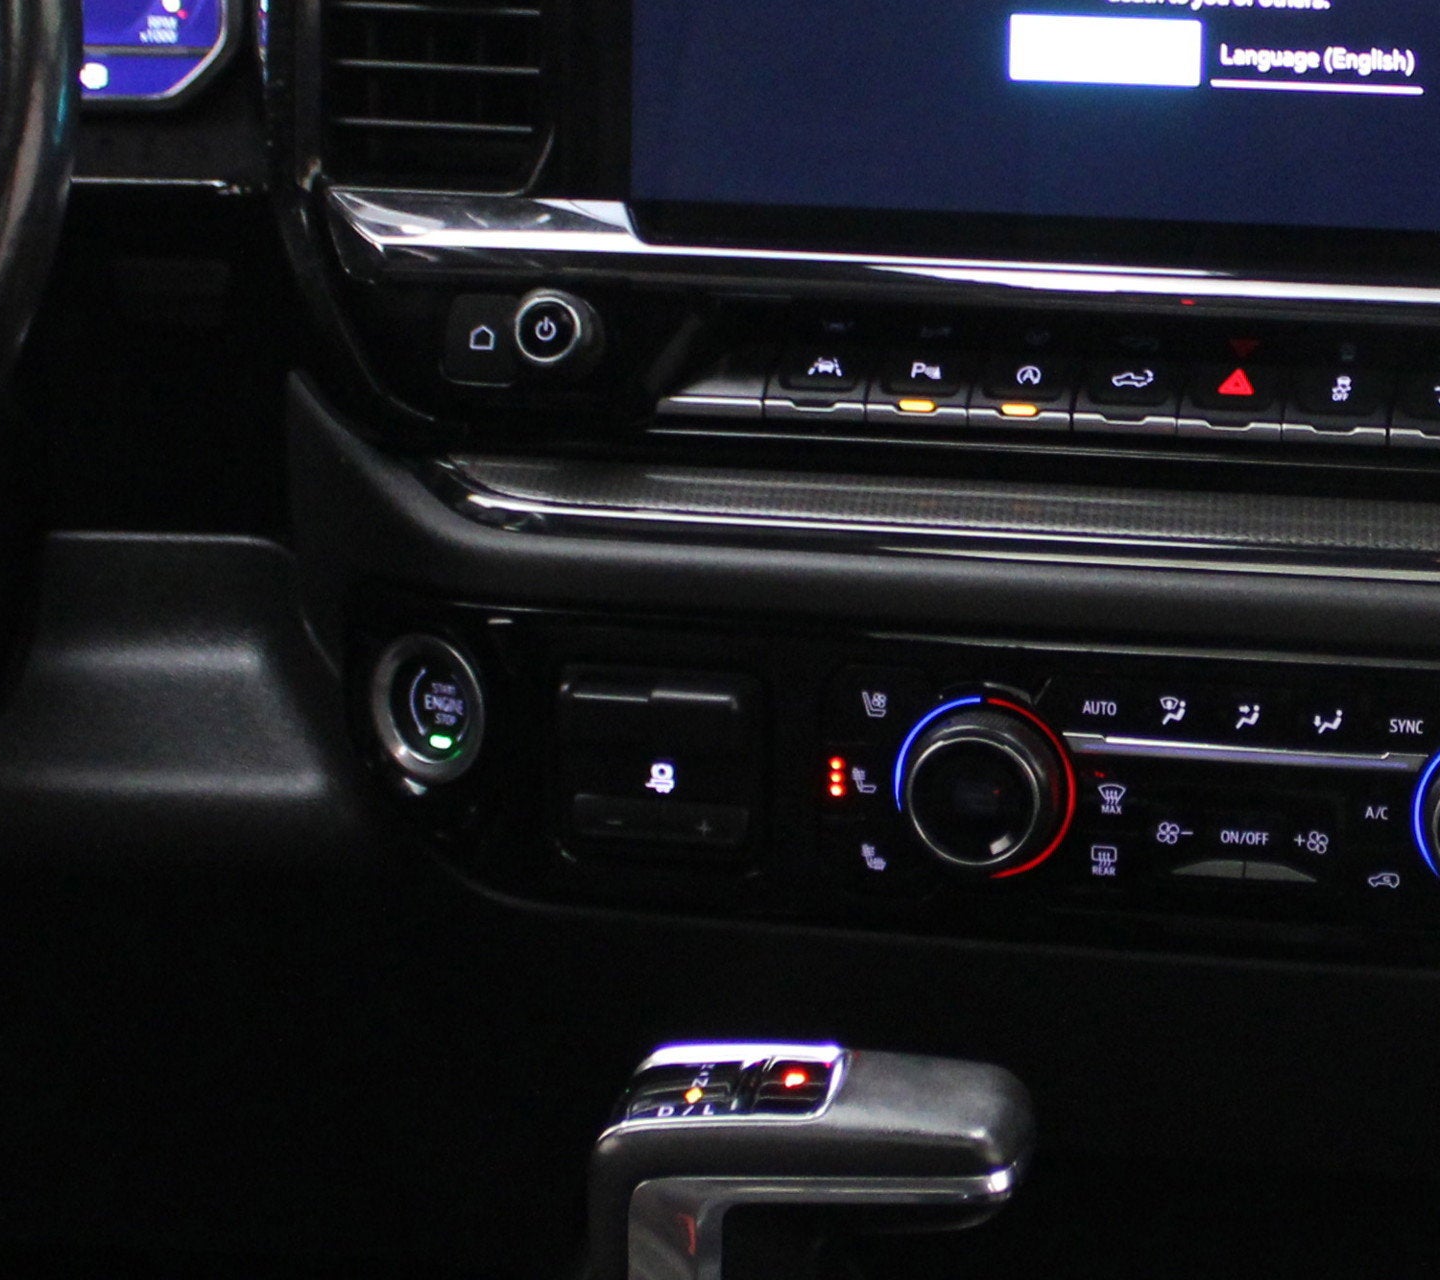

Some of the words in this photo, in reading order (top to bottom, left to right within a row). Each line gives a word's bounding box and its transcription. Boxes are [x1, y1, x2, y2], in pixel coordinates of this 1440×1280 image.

[1220, 43, 1320, 74] Language
[1323, 46, 1415, 77] (English)
[424, 694, 464, 716] ENGINE
[1082, 701, 1117, 716] AUTO
[1388, 718, 1424, 735] SYNC
[1101, 804, 1122, 815] MAX
[1364, 805, 1389, 820] A/C
[1220, 830, 1269, 846] ON/OFF
[1091, 865, 1116, 877] REAR
